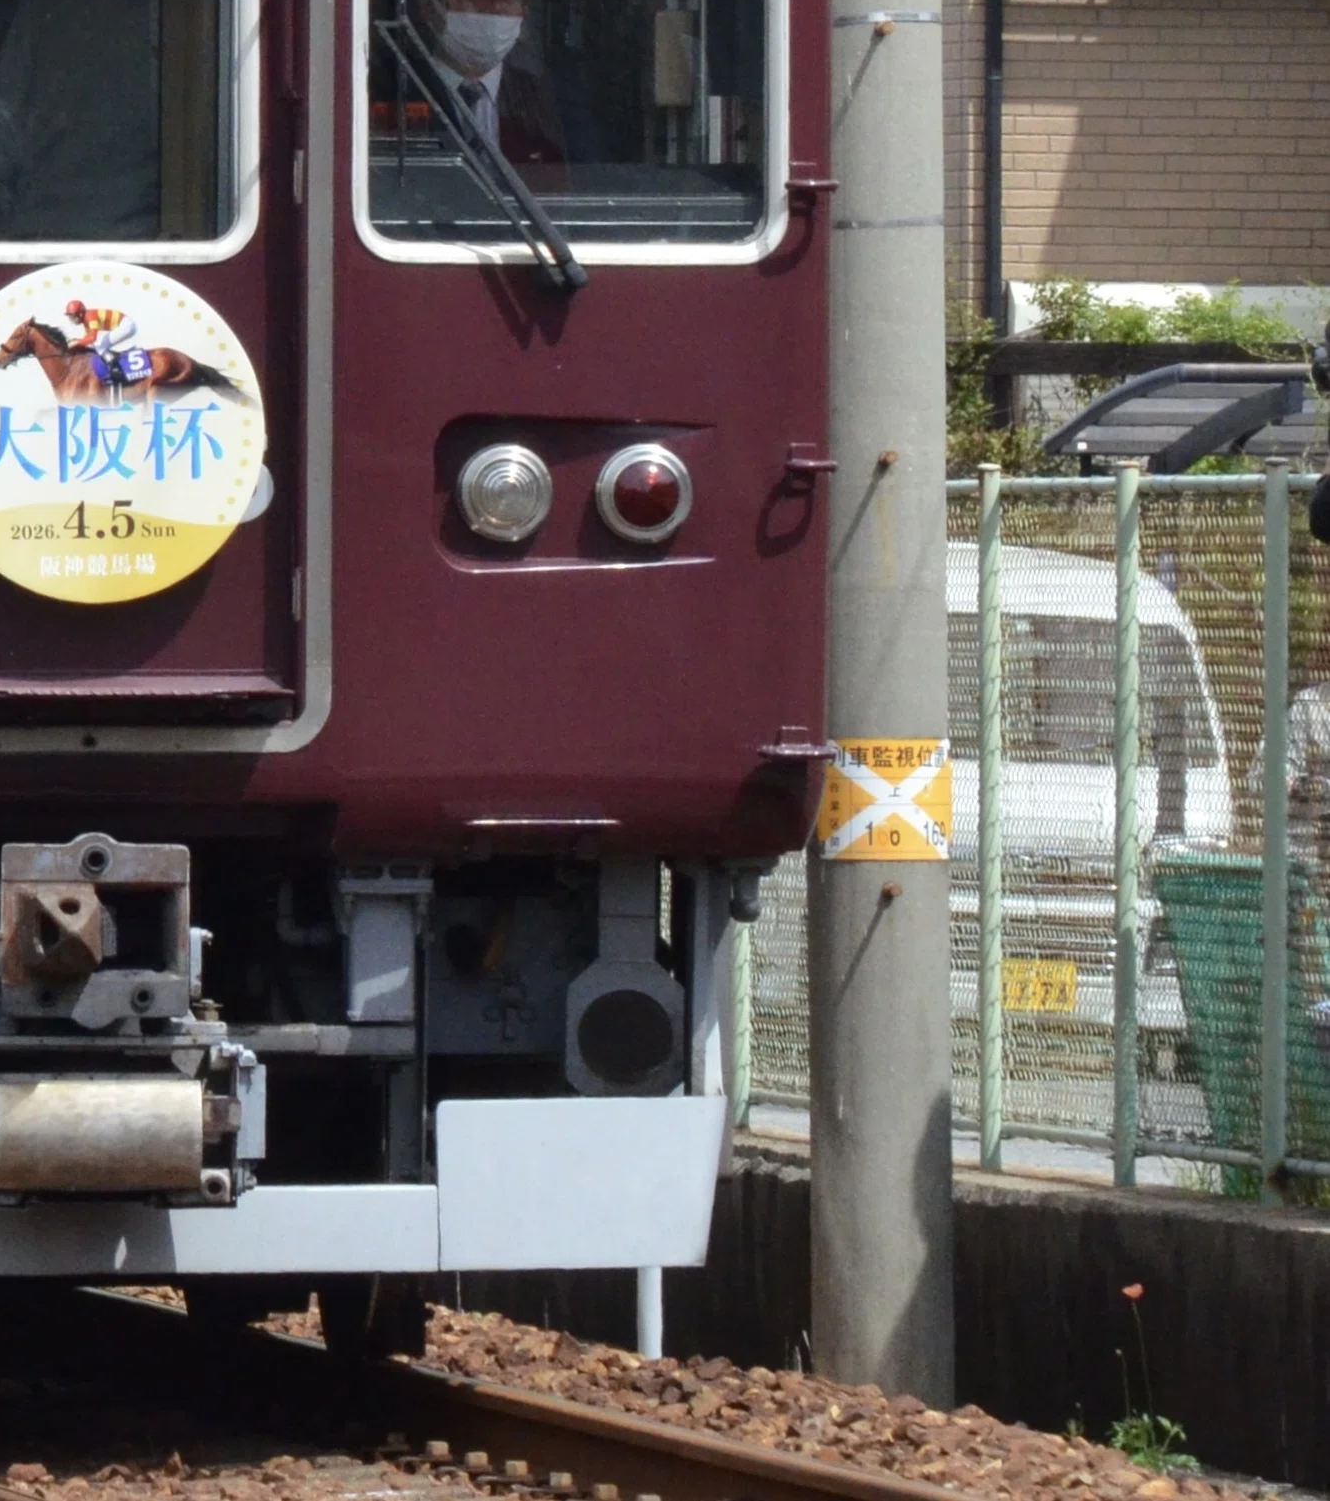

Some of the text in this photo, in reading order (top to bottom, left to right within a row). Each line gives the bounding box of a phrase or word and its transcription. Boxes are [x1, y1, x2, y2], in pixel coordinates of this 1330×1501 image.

[128, 349, 145, 371] 5
[63, 500, 135, 539] 4.5
[141, 522, 176, 538] Sun
